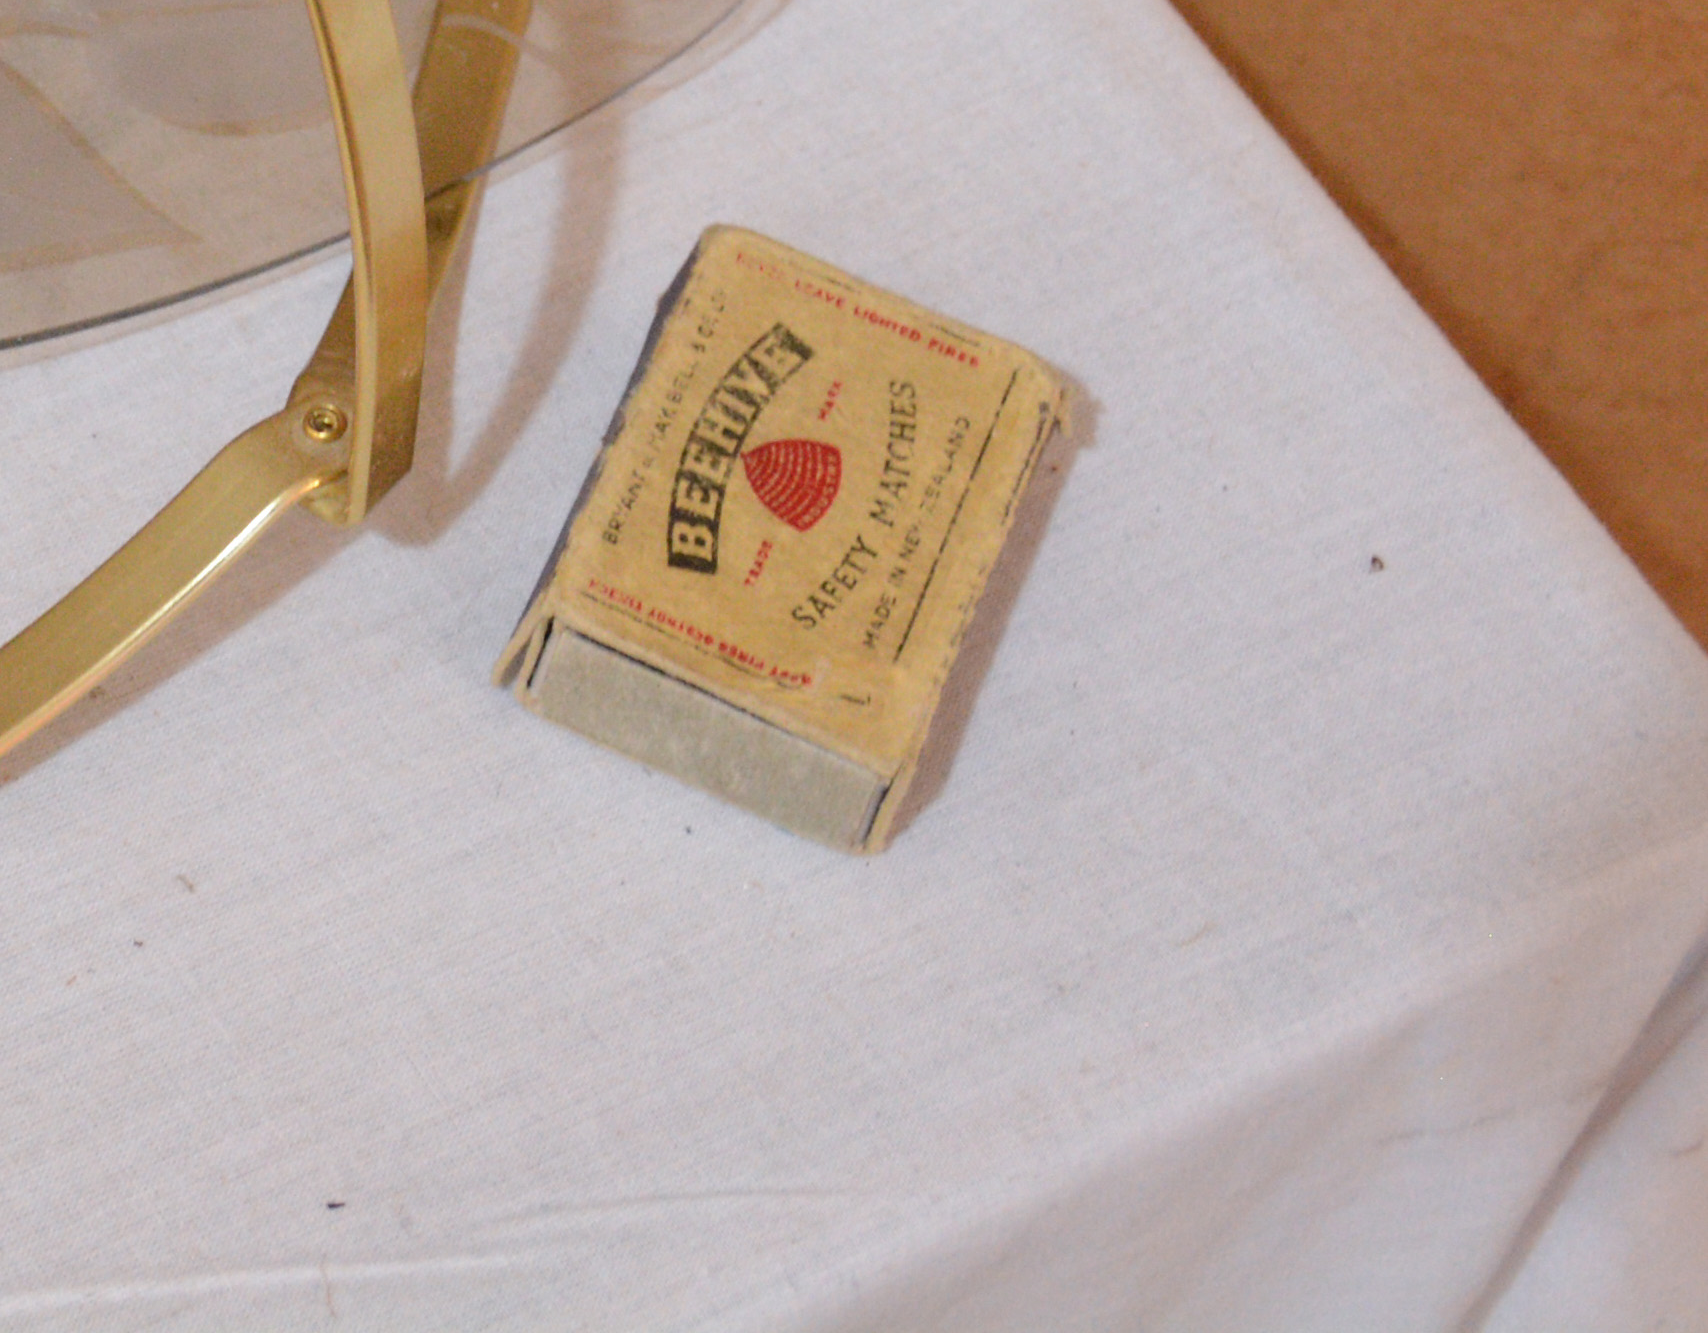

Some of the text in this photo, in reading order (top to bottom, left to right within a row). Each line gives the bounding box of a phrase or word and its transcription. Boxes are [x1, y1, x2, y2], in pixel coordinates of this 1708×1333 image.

[852, 304, 923, 343] LIGHTED
[669, 325, 810, 569] BEEHIVE
[743, 380, 843, 588] TRADE MARK
[790, 533, 879, 631] SAFETY
[869, 379, 918, 529] MATCHES
[862, 595, 897, 651] MADE
[887, 567, 908, 590] IN
[919, 415, 972, 517] ZEALAND
